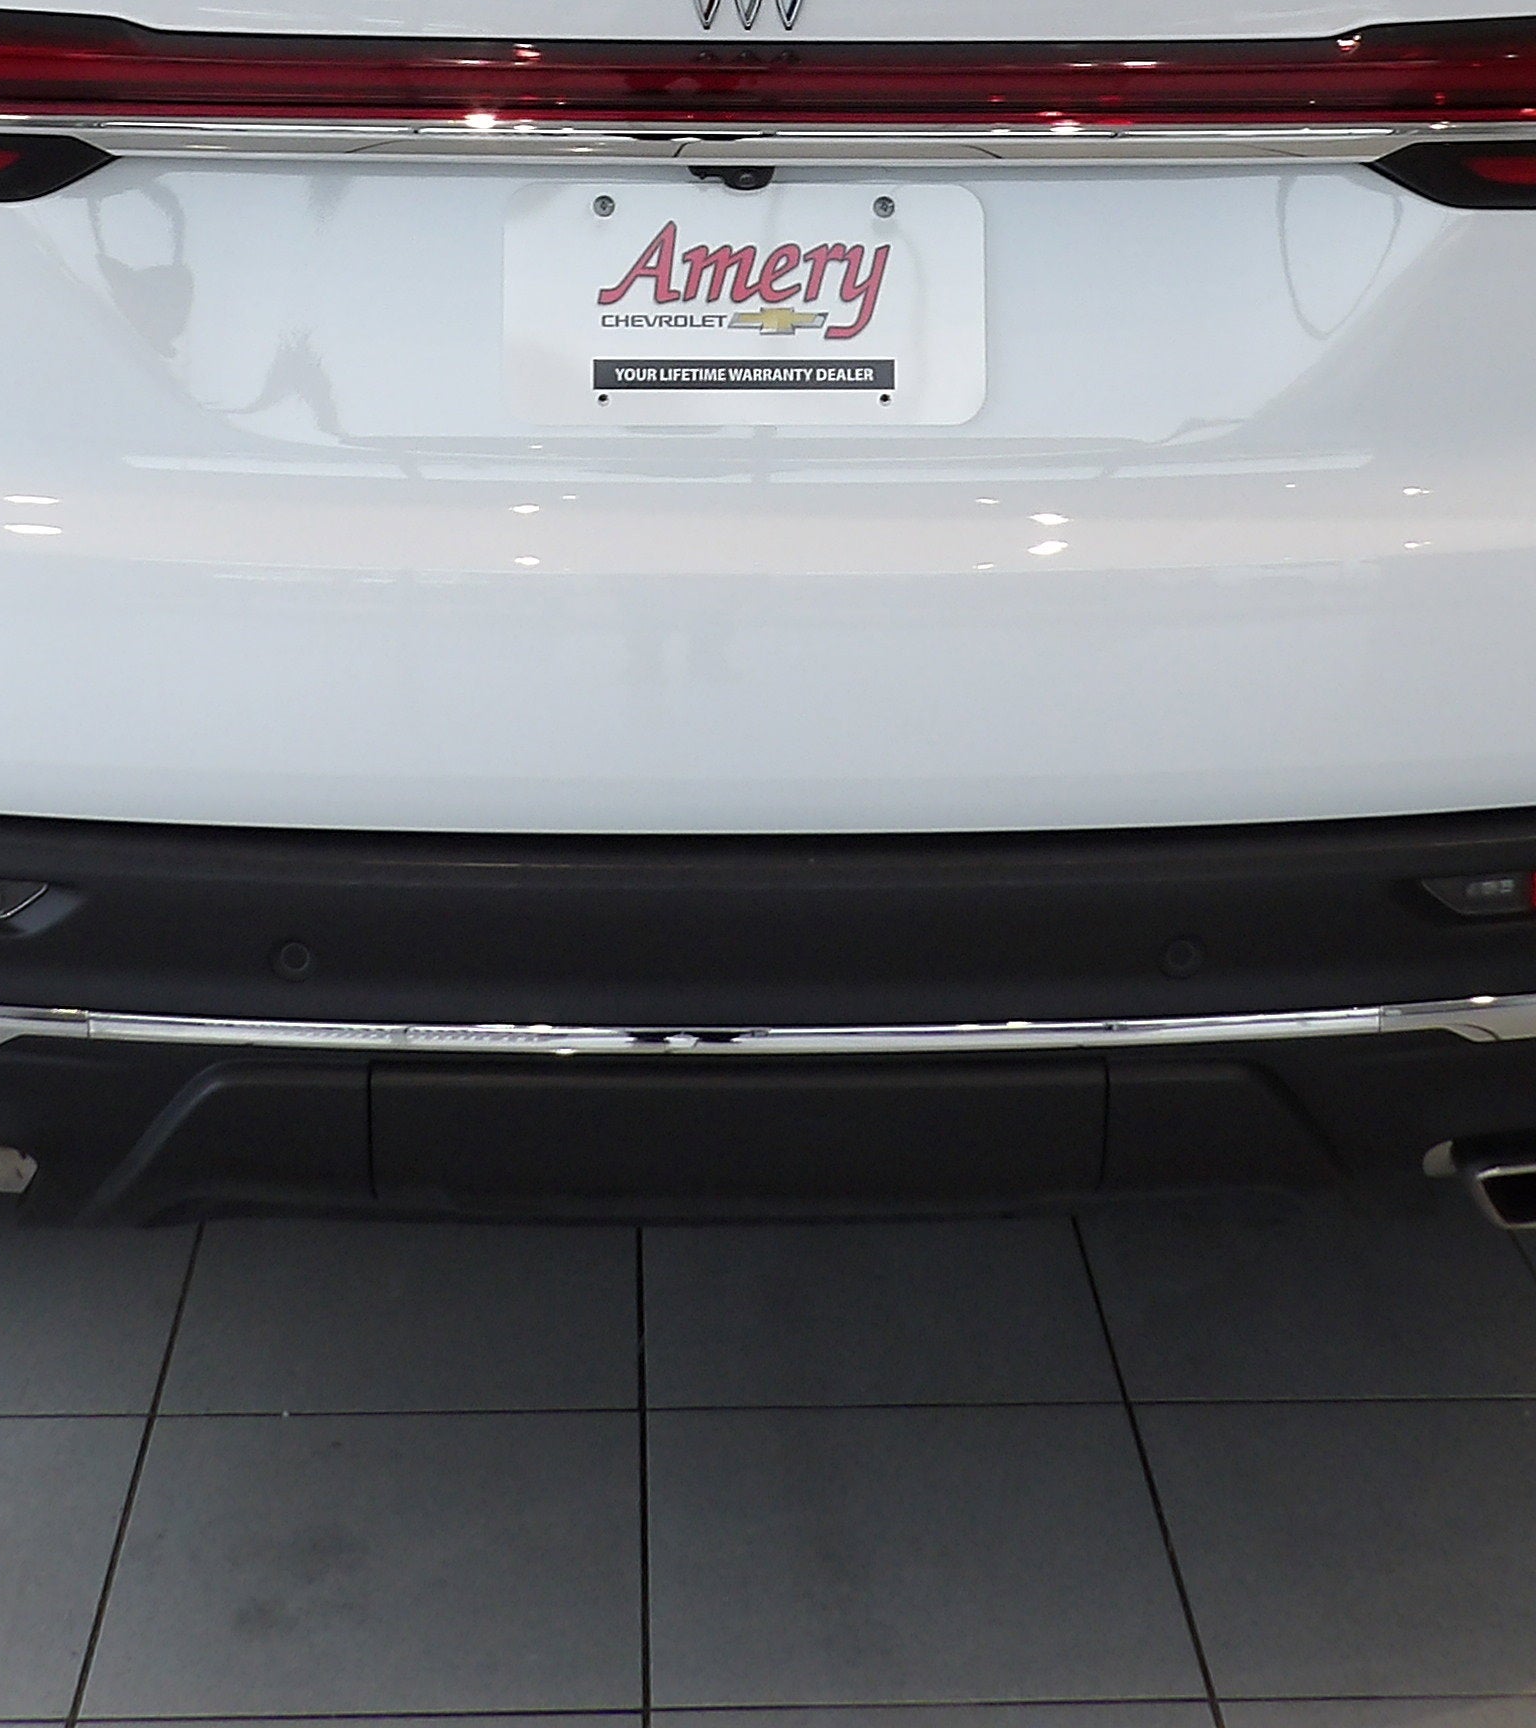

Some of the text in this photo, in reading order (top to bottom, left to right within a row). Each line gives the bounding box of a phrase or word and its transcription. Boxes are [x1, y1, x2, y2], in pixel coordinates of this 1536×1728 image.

[597, 220, 891, 340] Amery
[600, 314, 727, 328] CHEVROLET
[615, 367, 874, 382] YOUR LIFETIME WARRANTY DEALER
